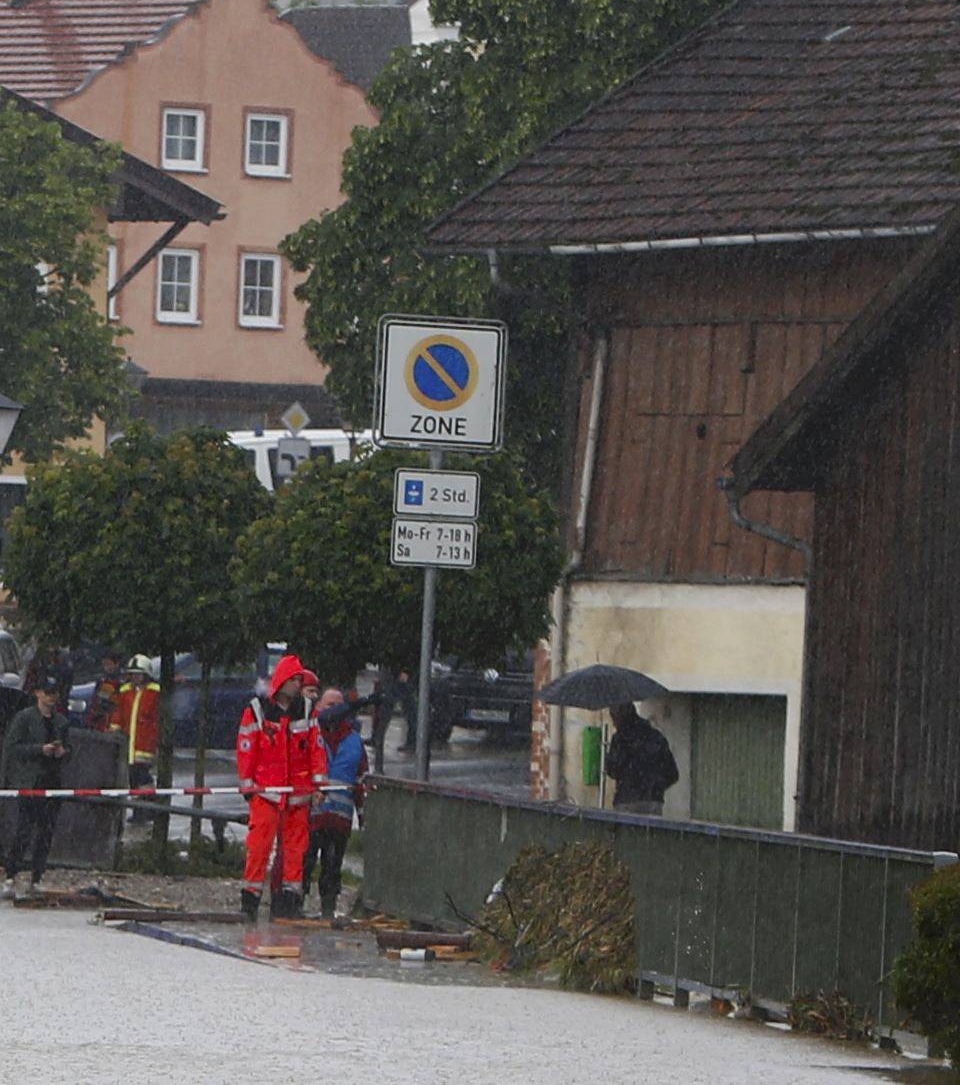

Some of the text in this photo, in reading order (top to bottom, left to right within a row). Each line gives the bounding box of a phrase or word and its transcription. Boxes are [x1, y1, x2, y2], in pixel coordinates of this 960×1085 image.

[410, 415, 467, 436] ZONE
[429, 487, 469, 504] 2 Std.
[397, 526, 471, 543] Mo-Fr 7-18 h
[396, 543, 471, 560] Sa 7-13 h
